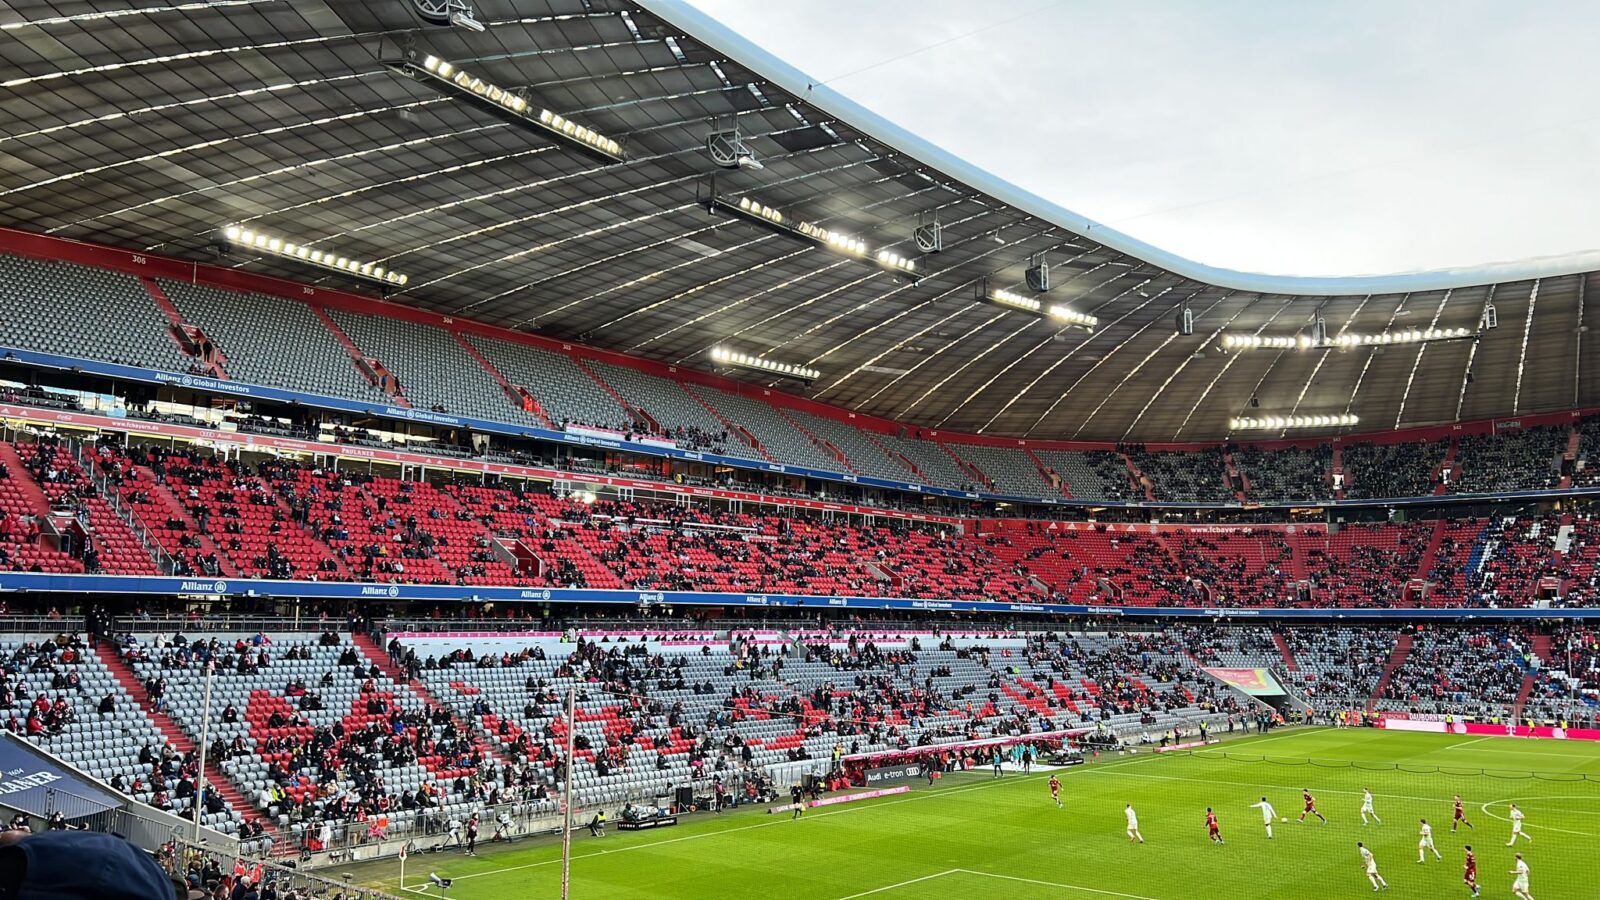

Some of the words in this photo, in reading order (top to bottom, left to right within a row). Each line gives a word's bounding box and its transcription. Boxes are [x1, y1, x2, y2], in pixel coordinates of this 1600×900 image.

[155, 373, 181, 383] Allianz
[193, 378, 216, 388] Global
[218, 383, 250, 393] Investors
[386, 407, 406, 417] Allianz
[415, 412, 432, 420] Global
[434, 415, 459, 424] Investors
[111, 420, 159, 431] www.fcbayern.de
[181, 581, 213, 591] Allianz
[361, 586, 388, 595] Allianz
[868, 772, 881, 781] Audi
[884, 770, 904, 779] e-tron
[0, 771, 62, 795] LANER
